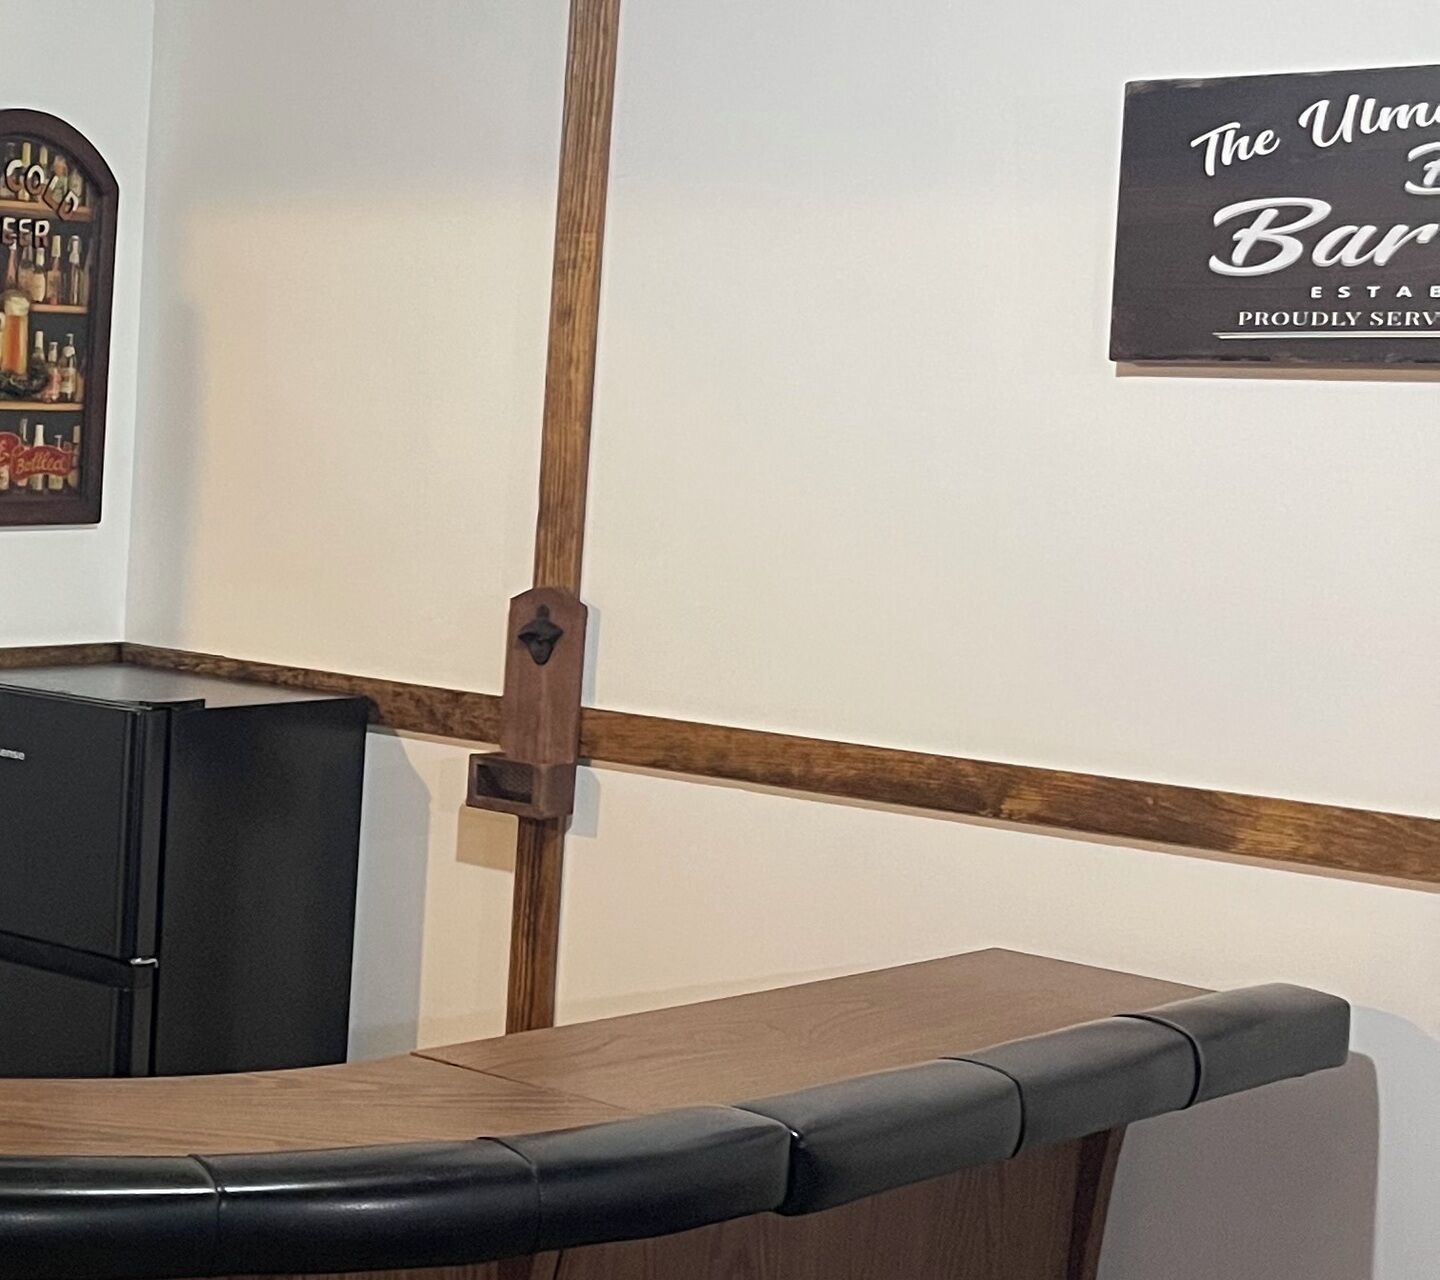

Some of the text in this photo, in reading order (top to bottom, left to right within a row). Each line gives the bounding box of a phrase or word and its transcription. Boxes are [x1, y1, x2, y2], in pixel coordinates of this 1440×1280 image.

[1190, 94, 1440, 176] The Ulm
[5, 159, 79, 220] COLD
[1209, 196, 1440, 276] Bar
[1238, 311, 1362, 327] PROUDLY
